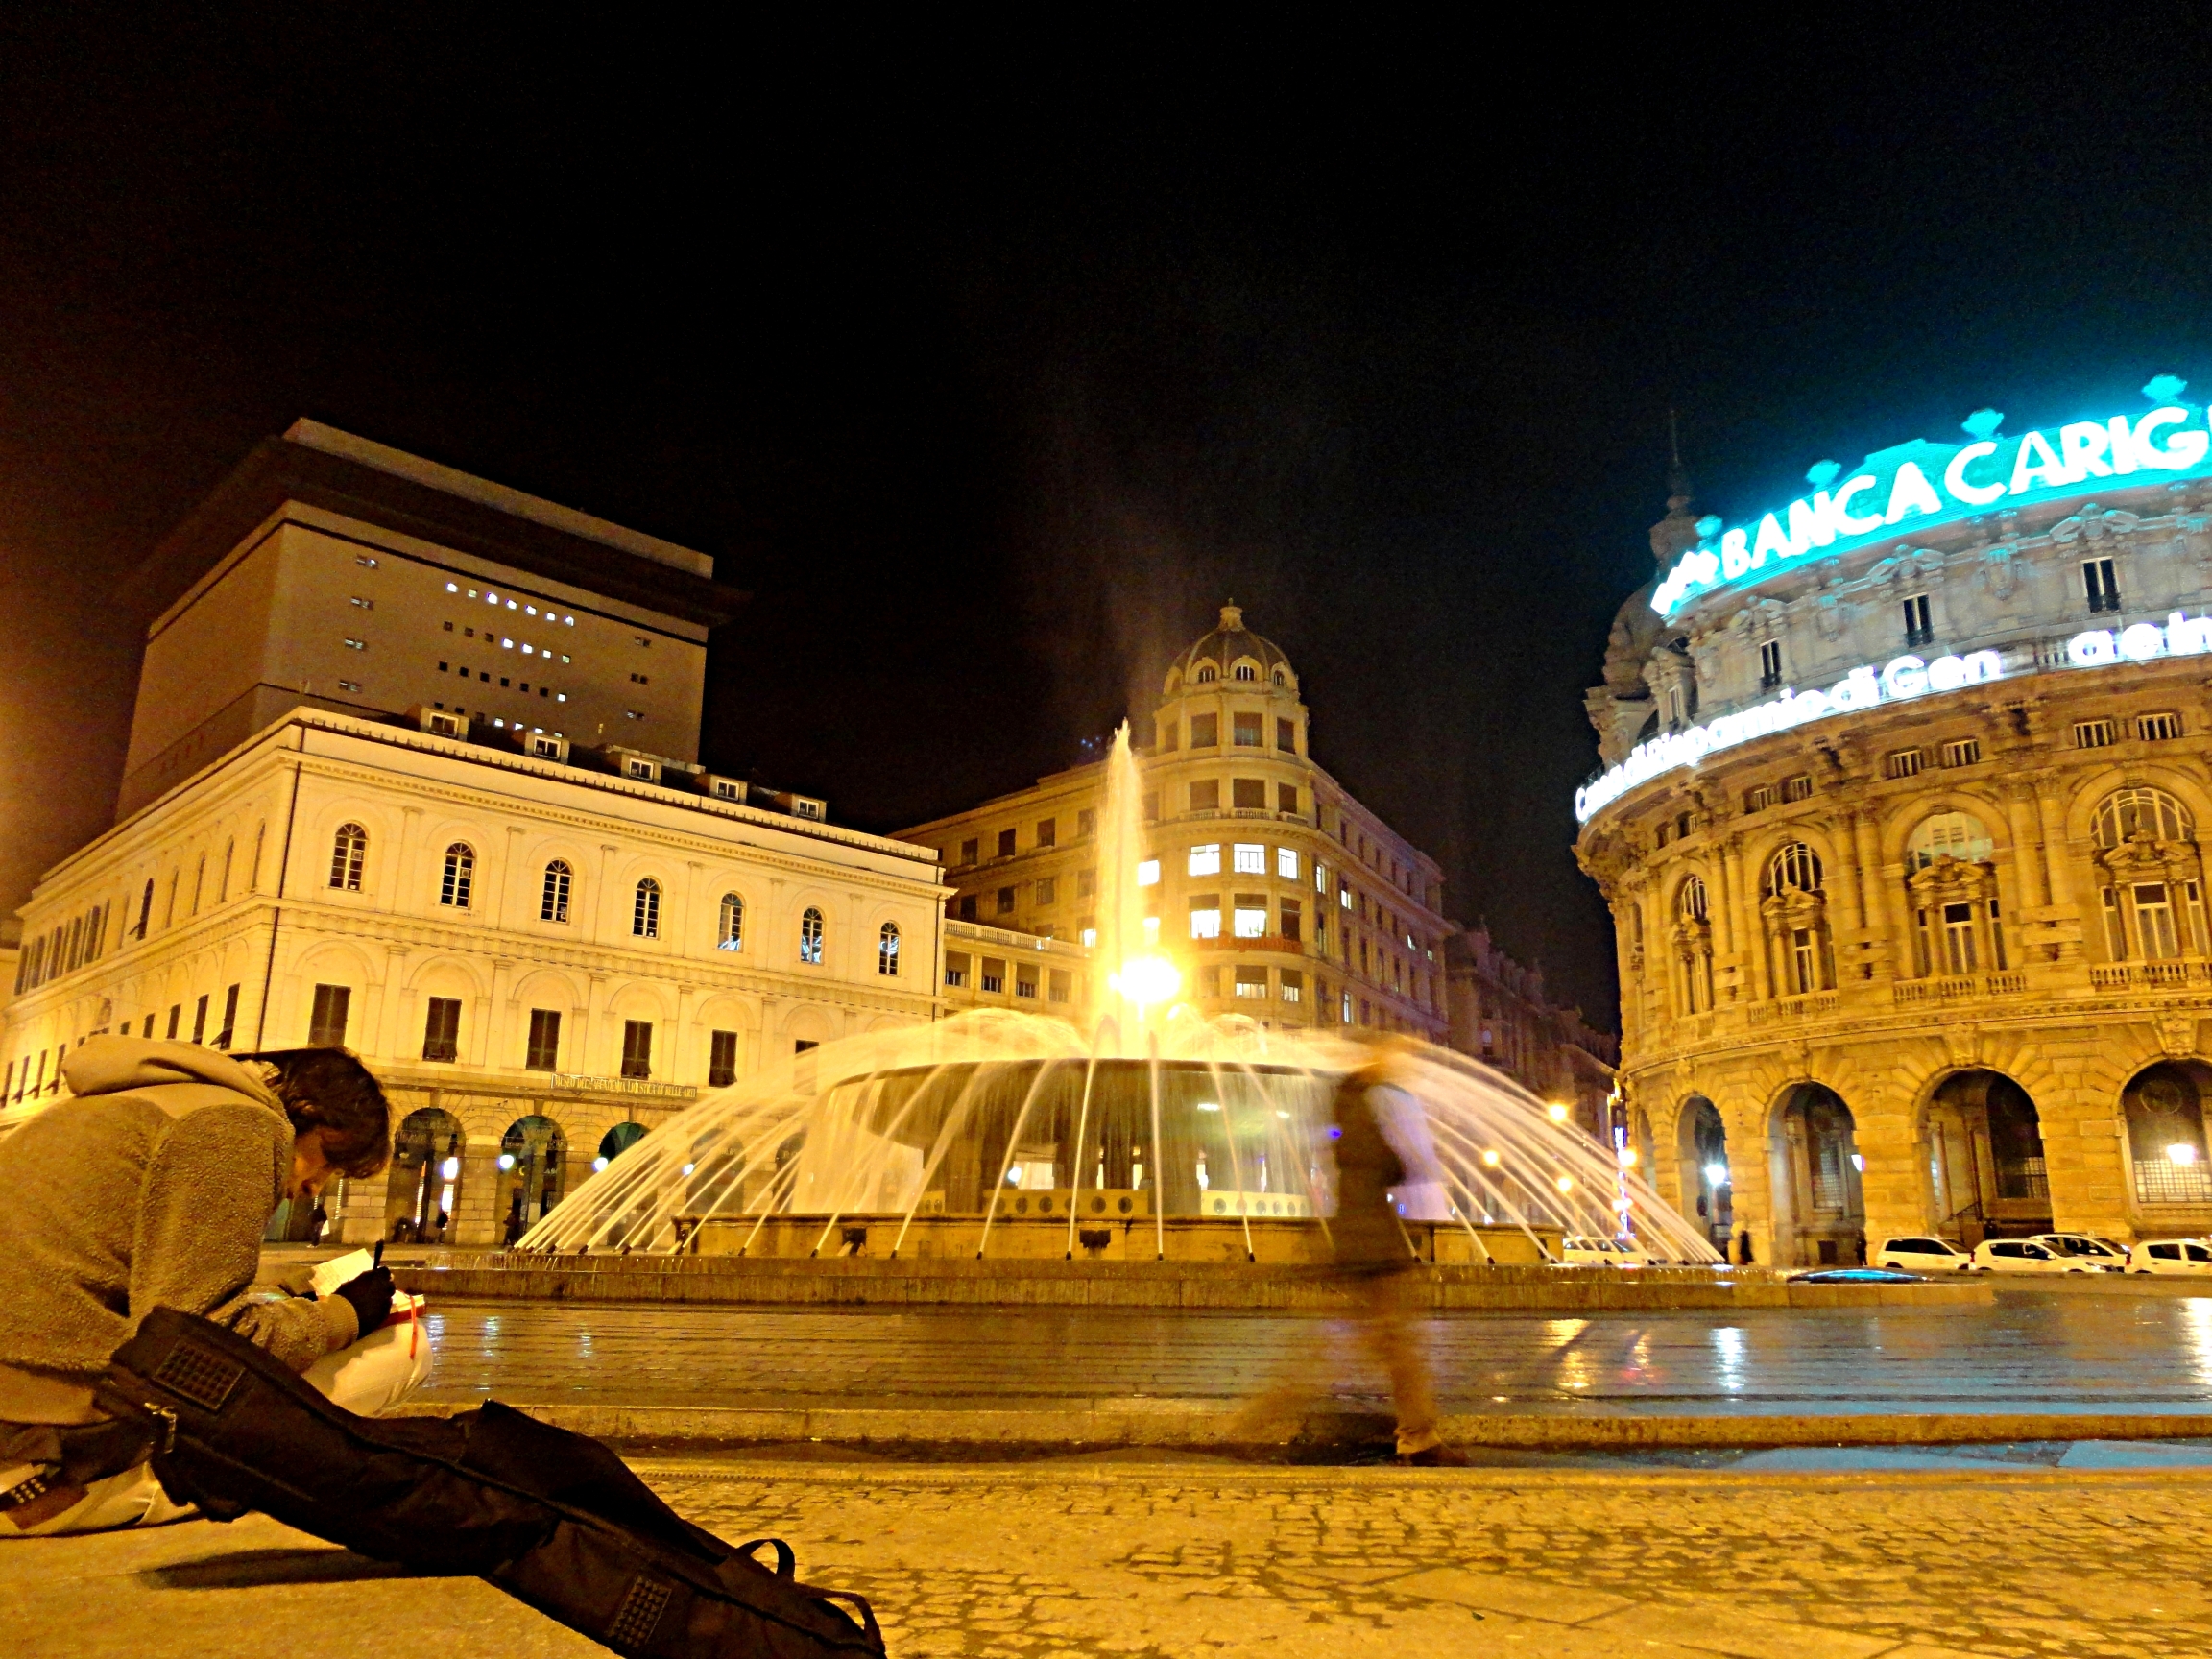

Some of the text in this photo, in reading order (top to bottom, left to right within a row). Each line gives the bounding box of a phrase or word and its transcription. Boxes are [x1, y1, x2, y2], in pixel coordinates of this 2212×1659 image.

[1721, 405, 2212, 579] BANCA CARIG
[1830, 666, 1879, 711] di
[555, 1075, 576, 1089] MUSEO
[665, 1086, 683, 1096] BELLE
[683, 1087, 696, 1098] ARTI
